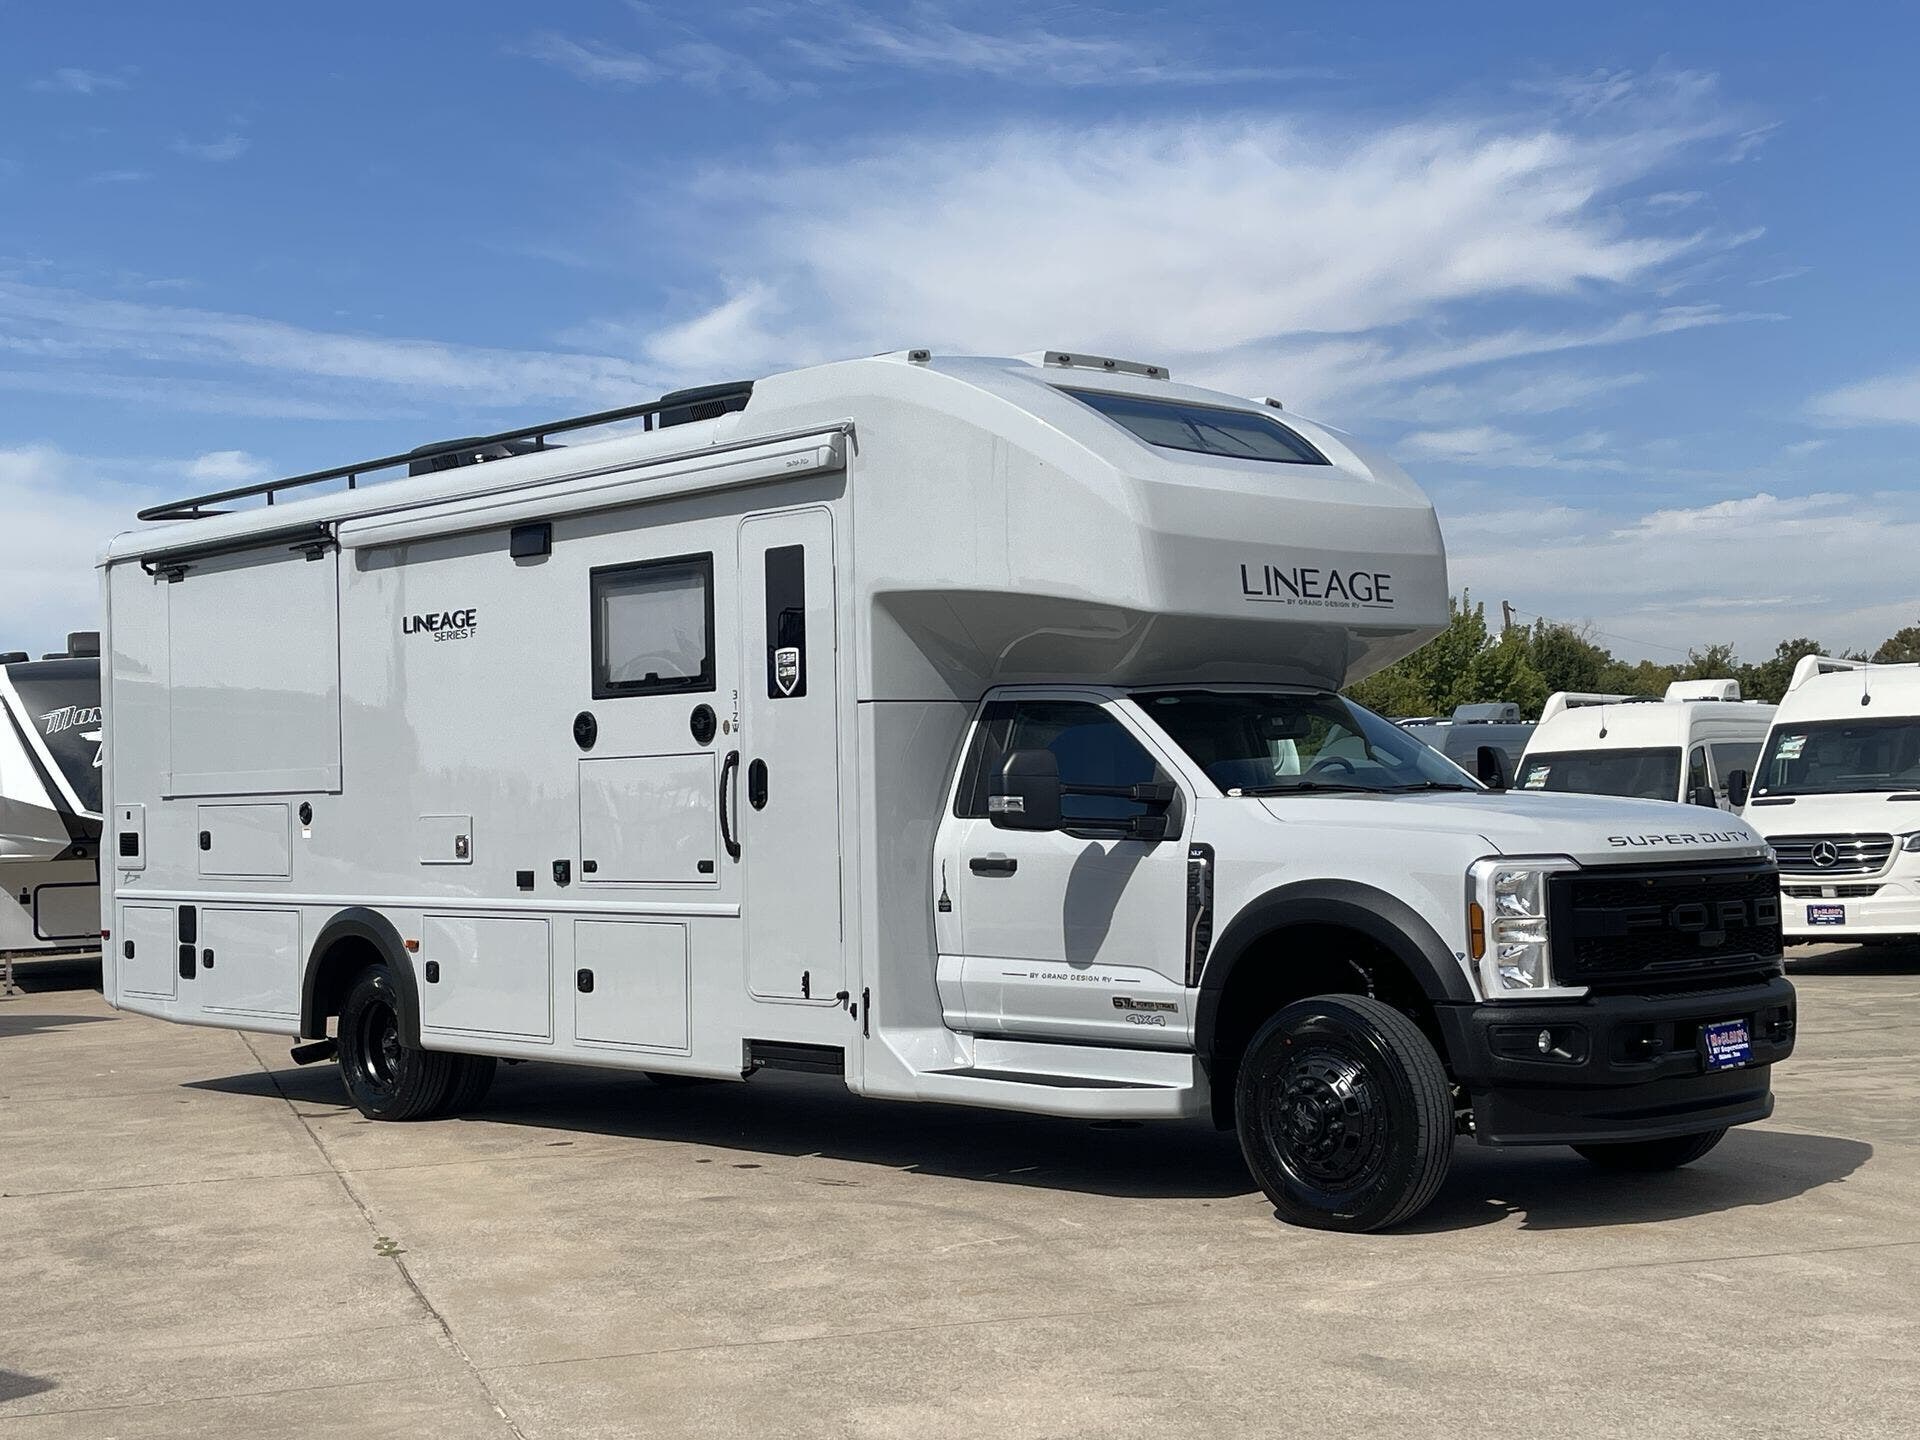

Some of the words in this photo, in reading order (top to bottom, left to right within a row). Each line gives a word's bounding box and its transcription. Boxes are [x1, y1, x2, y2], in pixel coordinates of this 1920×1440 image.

[1240, 564, 1394, 603] LINEAGE
[1324, 600, 1350, 608] DESIGN
[402, 608, 478, 634] LINEAGE
[433, 628, 468, 642] SERIES
[470, 627, 477, 638] F
[1607, 833, 1699, 847] SUPER
[1700, 831, 1750, 843] DUTY
[1041, 973, 1068, 981] GRAND
[1070, 974, 1100, 982] DESIGN
